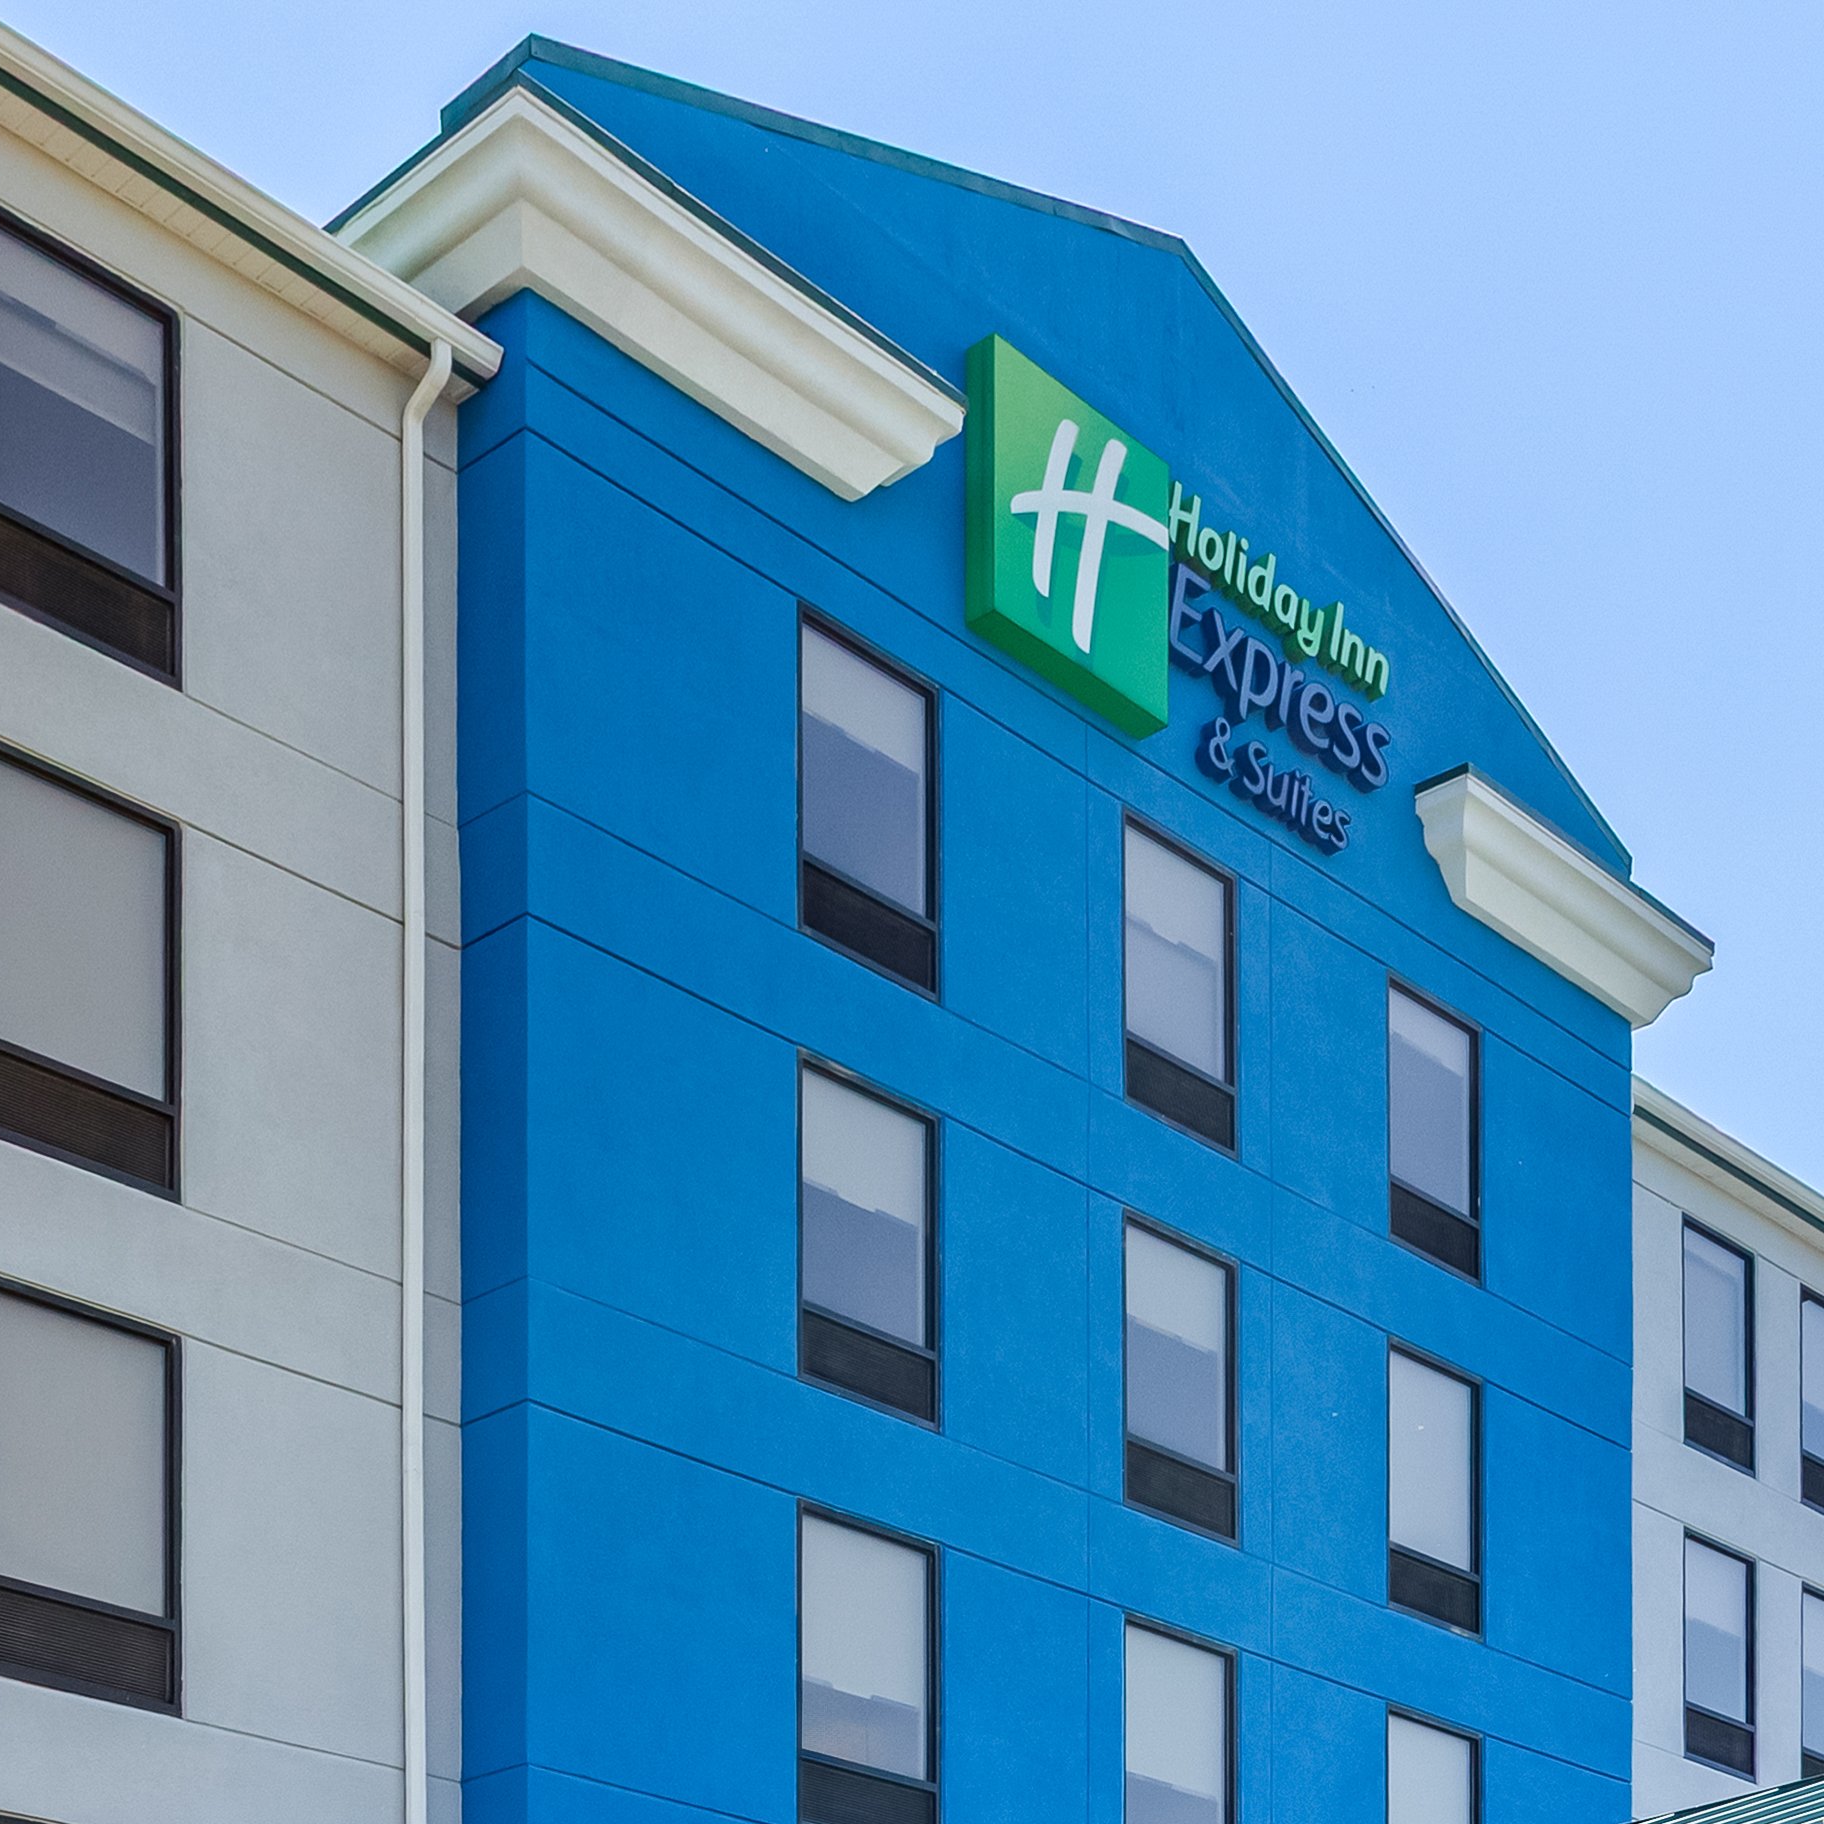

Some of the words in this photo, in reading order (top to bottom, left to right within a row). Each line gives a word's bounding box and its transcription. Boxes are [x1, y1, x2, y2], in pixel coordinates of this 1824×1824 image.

[1168, 480, 1325, 658] Holiday
[1329, 601, 1390, 696] Inn
[1169, 562, 1391, 788] Express
[1208, 715, 1236, 777] &
[1242, 740, 1351, 850] Suites
